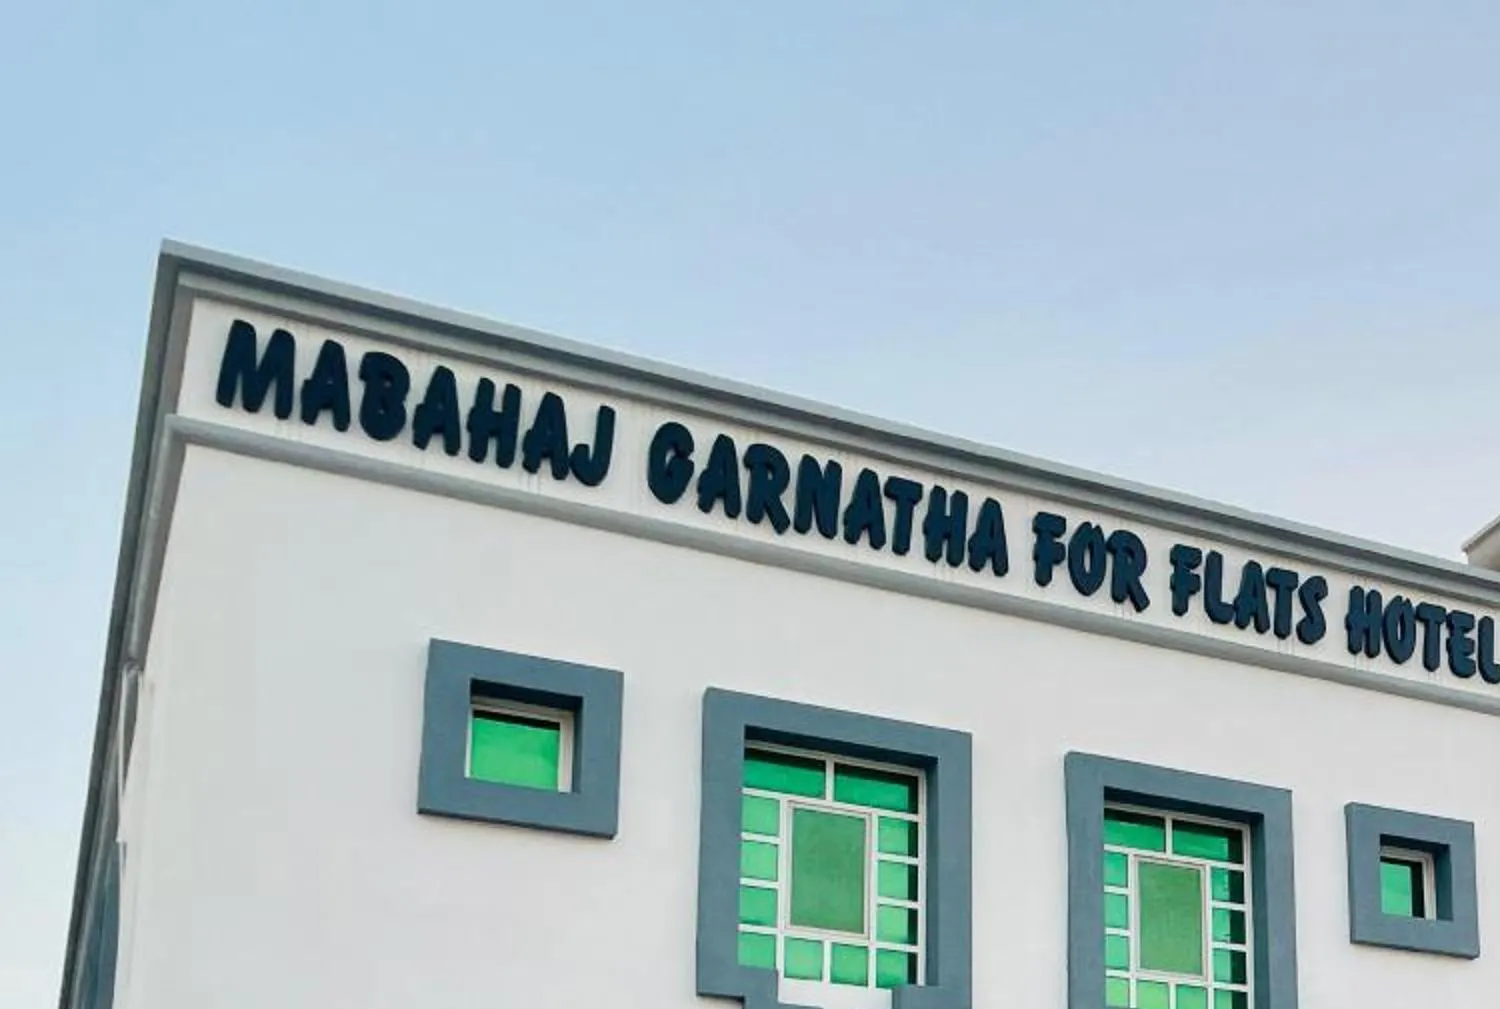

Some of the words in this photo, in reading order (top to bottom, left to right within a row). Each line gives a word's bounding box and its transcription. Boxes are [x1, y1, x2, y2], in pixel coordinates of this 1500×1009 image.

[215, 318, 616, 487] MABAHAJ
[647, 421, 1009, 577] GARNATHA
[1032, 511, 1151, 612] FOR
[1169, 543, 1329, 645] FLATS
